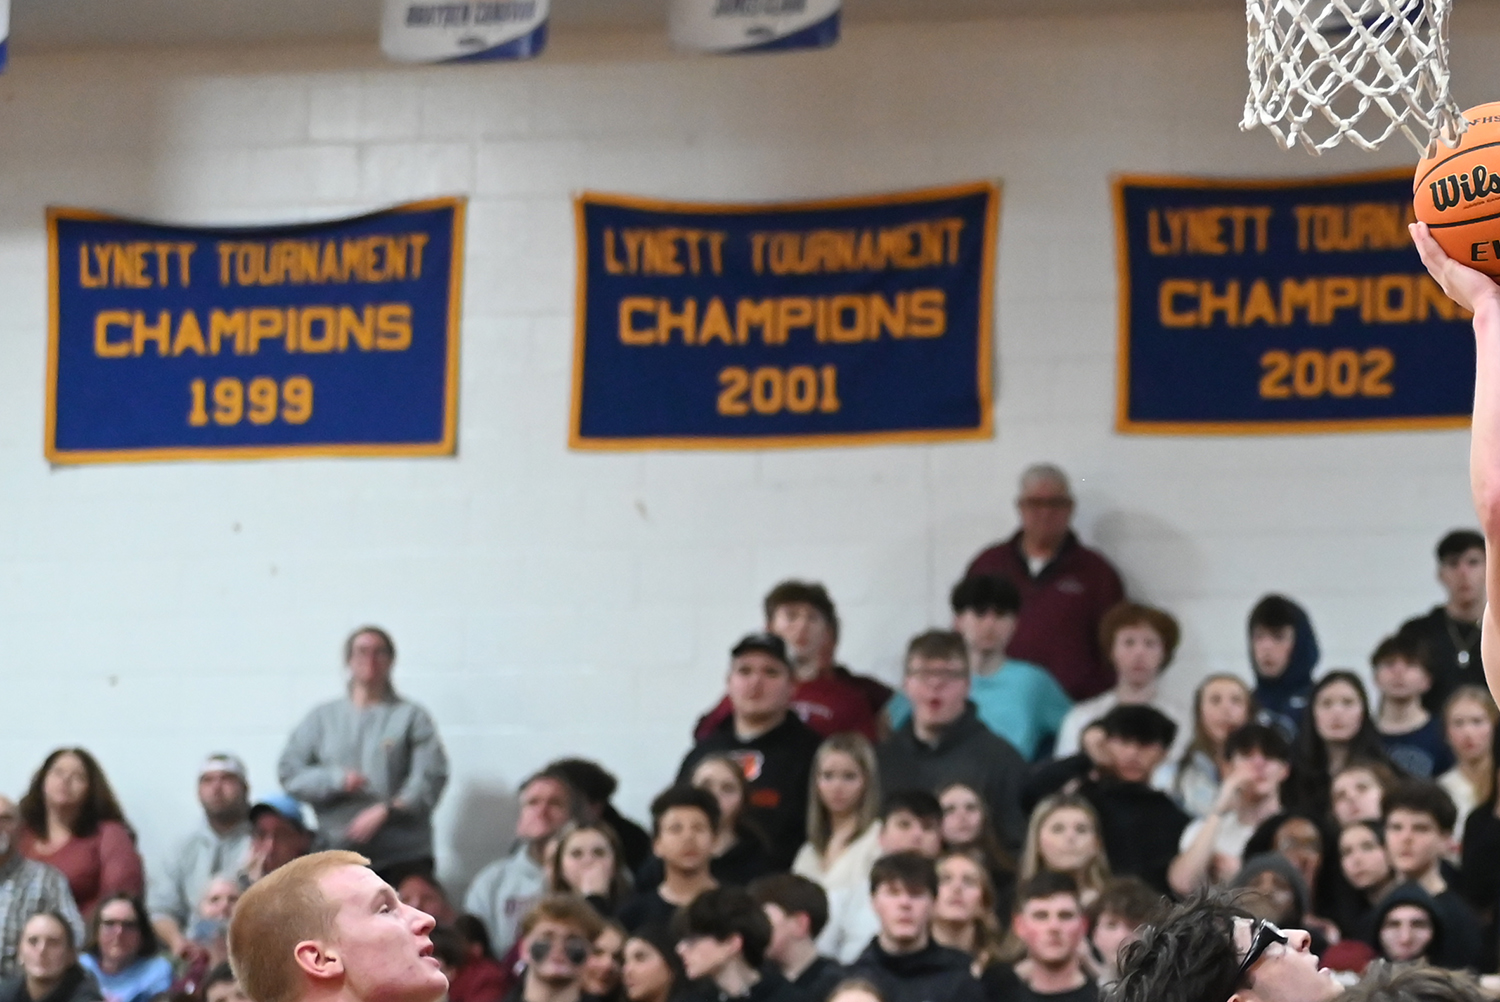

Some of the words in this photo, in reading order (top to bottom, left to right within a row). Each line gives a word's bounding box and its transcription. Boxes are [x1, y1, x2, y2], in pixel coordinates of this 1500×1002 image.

[603, 228, 726, 276] LYNETT
[751, 218, 965, 275] TOURNAMENT
[1147, 206, 1271, 255] LYNETT
[79, 242, 196, 288] LYNETT
[218, 234, 429, 284] TOURNAMENT
[619, 289, 946, 345] CHAMPIONS
[1159, 276, 1473, 327] CHAMPION
[94, 305, 413, 357] CHAMPIONS
[717, 366, 840, 416] 2001
[1259, 349, 1394, 397] 2002
[188, 377, 314, 426] 1999
